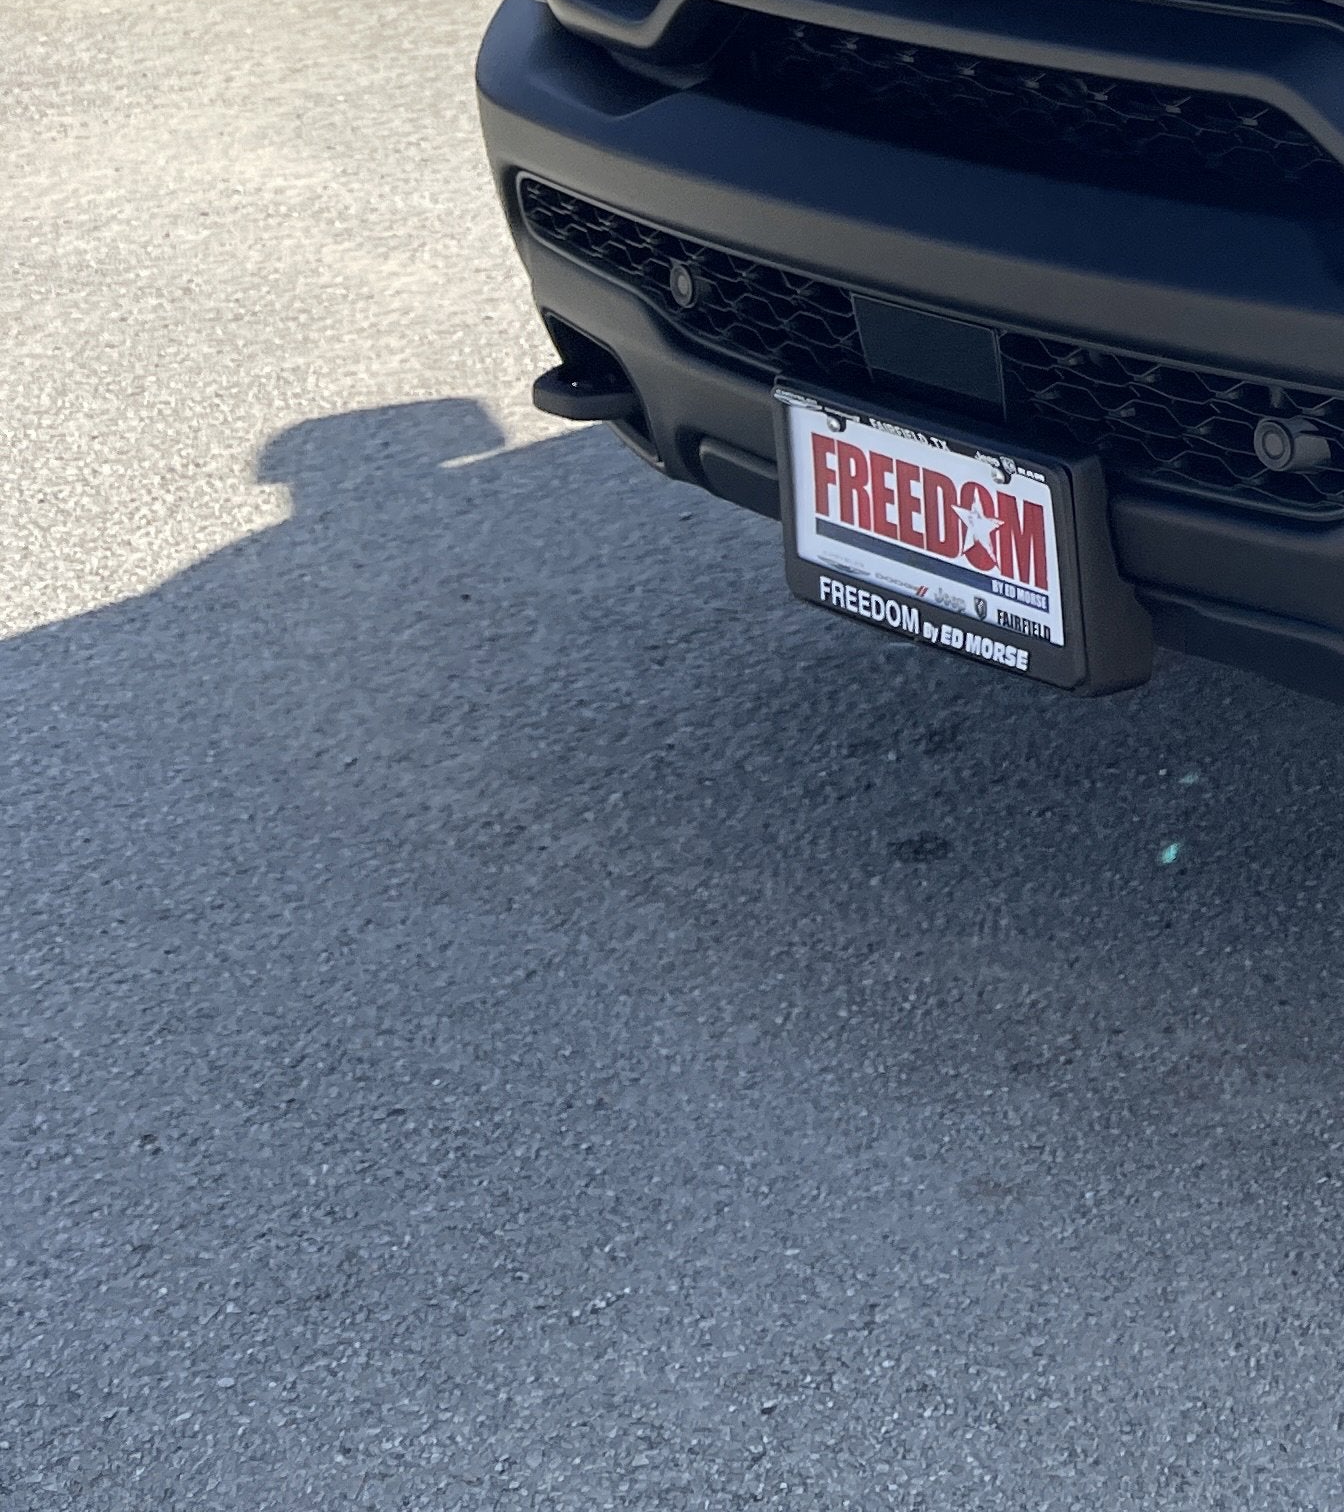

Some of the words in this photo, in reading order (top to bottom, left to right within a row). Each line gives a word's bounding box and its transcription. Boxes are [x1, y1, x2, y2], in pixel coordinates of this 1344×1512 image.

[810, 431, 1049, 592] FREEDOM
[818, 574, 921, 636] FREEDOM
[922, 622, 939, 644] By
[940, 624, 964, 650] ED
[965, 632, 1030, 672] MORSE
[991, 579, 1004, 595] BY
[1004, 583, 1016, 599] ED
[1016, 587, 1048, 610] MORSE
[996, 609, 1051, 642] FAIRFIELD
